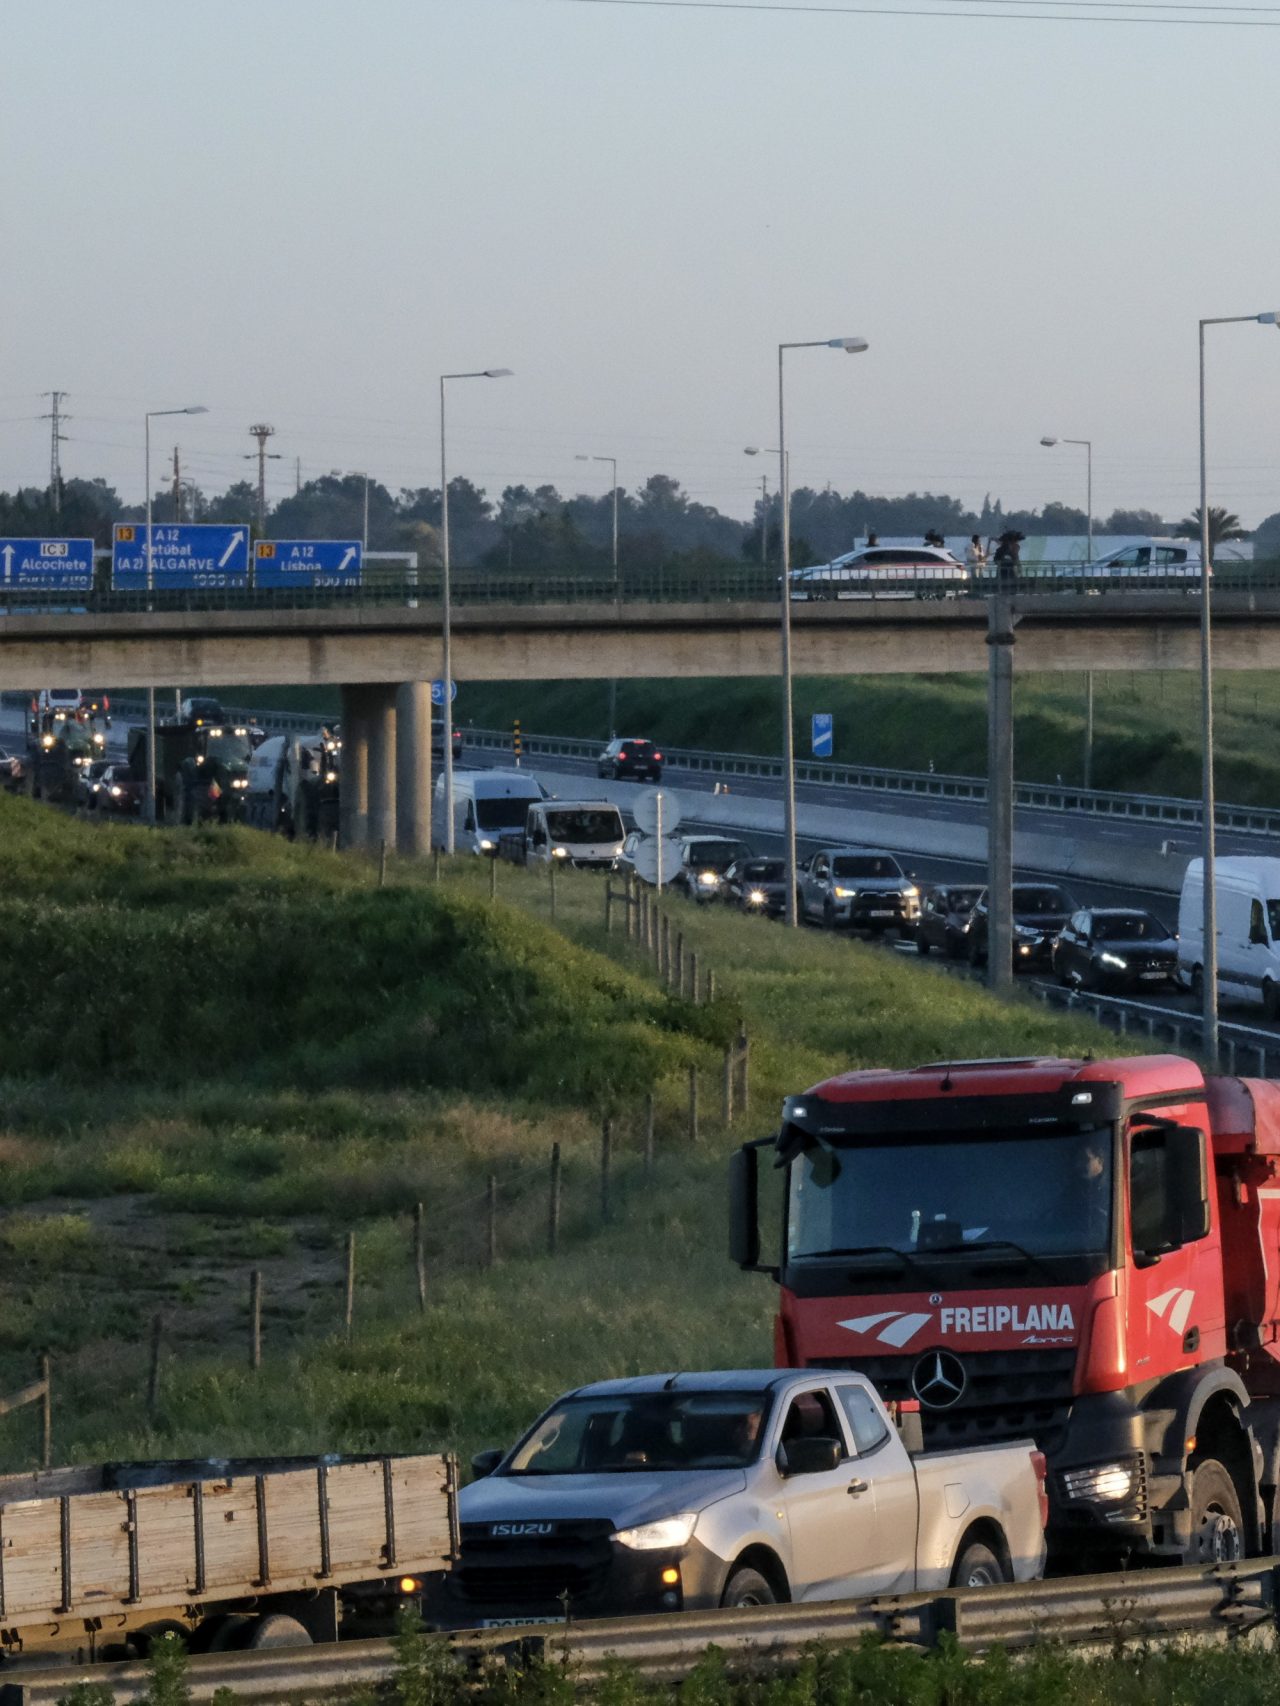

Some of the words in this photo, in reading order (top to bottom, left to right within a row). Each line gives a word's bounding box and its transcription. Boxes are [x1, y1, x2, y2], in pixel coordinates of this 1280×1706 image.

[119, 527, 133, 539] 13
[155, 530, 165, 540] A
[168, 529, 179, 540] 12
[42, 544, 57, 554] IC
[59, 544, 67, 555] 3
[141, 543, 192, 556] Setúbal
[291, 546, 300, 557] A
[302, 546, 314, 557] 12
[21, 558, 87, 570] Alcochete
[150, 558, 215, 570] ALGARVE
[281, 561, 322, 571] Lisboa
[941, 1304, 1075, 1334] FREIPLANA
[492, 1523, 552, 1536] ISUZU
